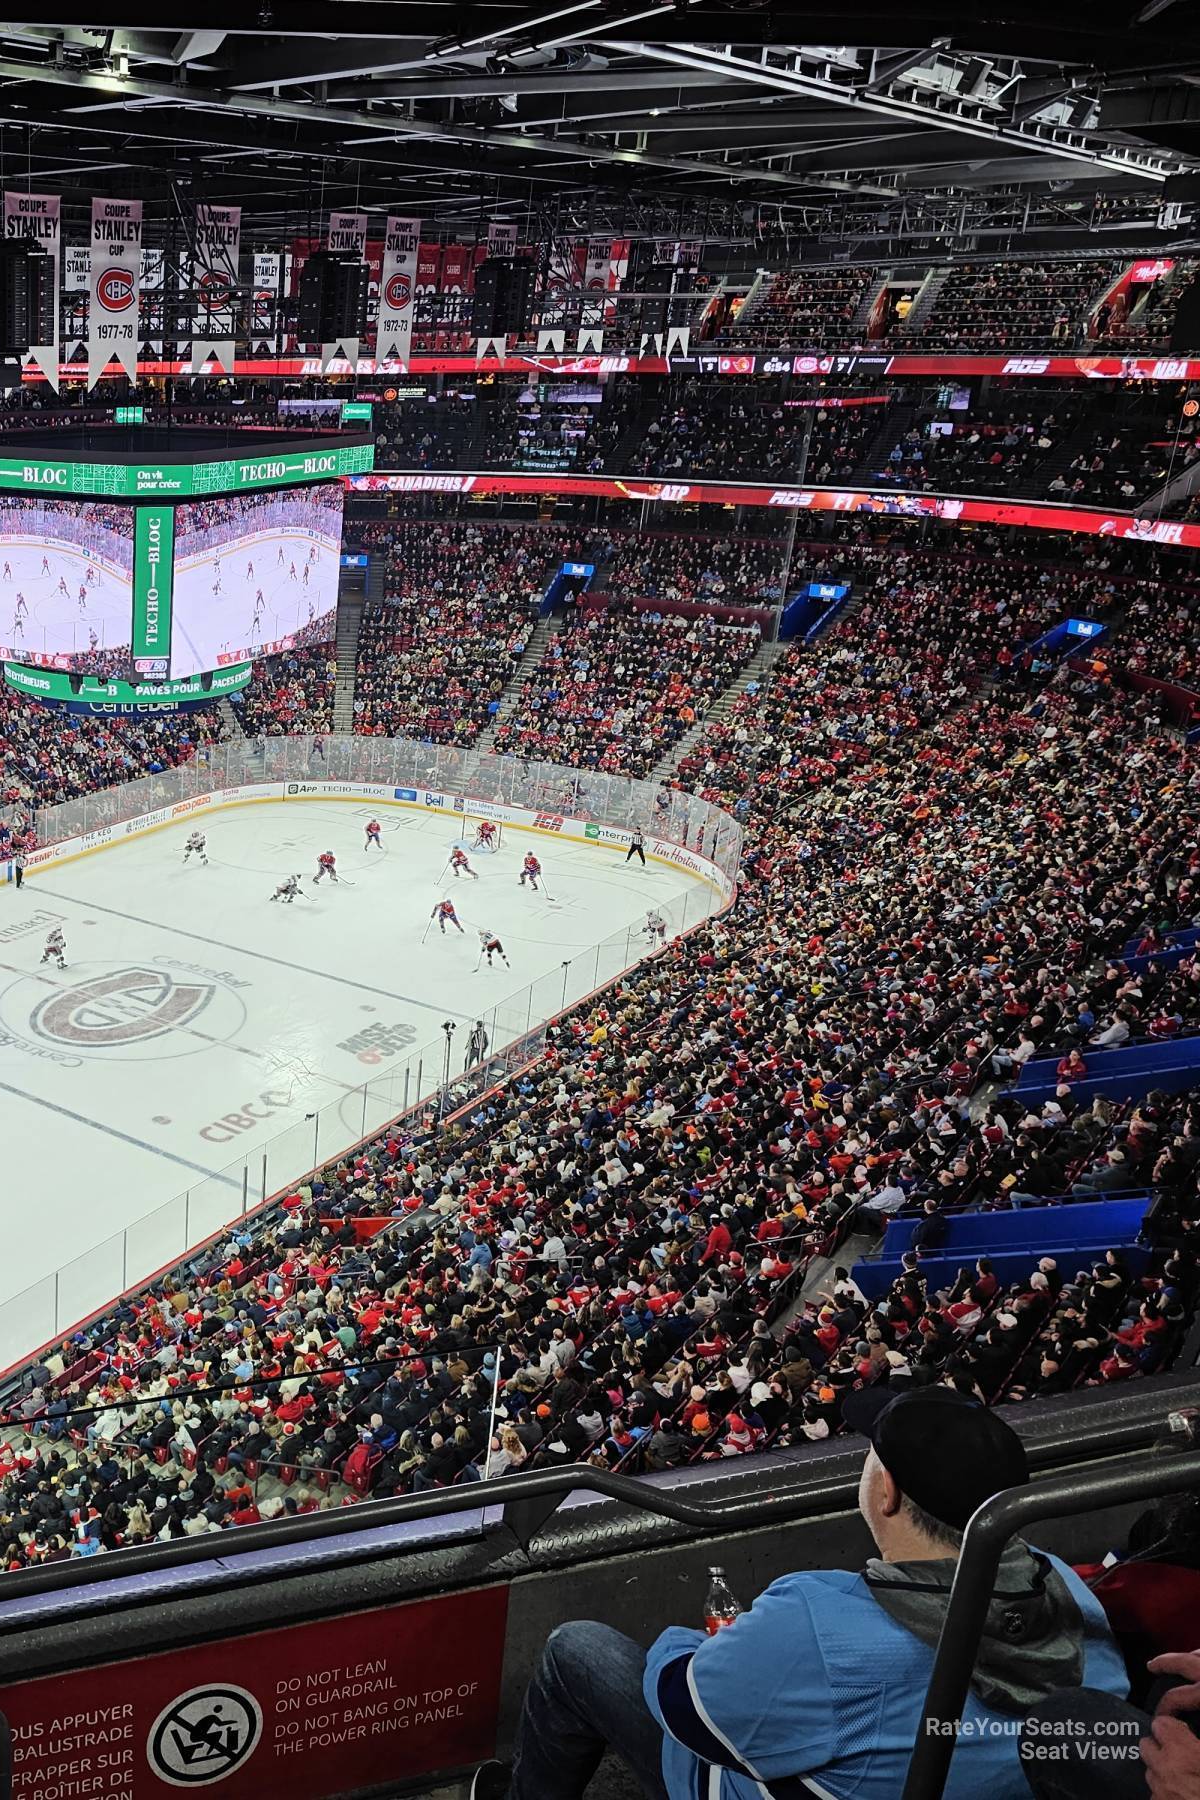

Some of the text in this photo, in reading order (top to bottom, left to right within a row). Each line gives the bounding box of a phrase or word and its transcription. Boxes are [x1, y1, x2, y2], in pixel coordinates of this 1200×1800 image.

[19, 199, 47, 213] COUPE
[105, 204, 130, 217] COUPE
[208, 211, 231, 223] COUPE
[7, 214, 58, 239] STANLEY
[94, 219, 141, 242] STANLEY
[394, 222, 414, 233] COUPE
[197, 224, 239, 246] STANLEY
[330, 231, 365, 250] STANLEY
[386, 233, 419, 252] STANLEY
[74, 250, 90, 259] COUPE
[109, 244, 125, 256] CUP
[396, 254, 407, 264] CUP
[254, 265, 278, 277] STANLEY
[76, 275, 86, 283] CUP
[96, 324, 133, 339] 1977-78
[383, 319, 408, 332] 1972-73
[600, 357, 629, 371] MLB
[721, 360, 730, 370] 0
[763, 361, 790, 372] 6:54
[1152, 362, 1188, 379] NBA
[137, 470, 163, 480] On vit
[137, 479, 182, 490] pour créer
[387, 477, 462, 491] CANADIENS
[660, 485, 690, 499] ATP
[833, 493, 855, 509] F1
[1155, 521, 1185, 542] NFL
[572, 565, 585, 574] Bell
[820, 585, 836, 596] Bell
[1077, 623, 1093, 635] Bell
[172, 682, 200, 695] POUR
[171, 803, 190, 818] pizza
[191, 796, 211, 811] pizza
[425, 793, 444, 807] Bell
[532, 813, 565, 832] IGA
[81, 827, 112, 843] THE KEG
[652, 840, 670, 860] Tim
[670, 848, 703, 873] Hortons
[152, 955, 253, 988] CentreBell
[336, 1022, 394, 1055] MISE
[199, 1102, 276, 1143] CIBC
[276, 1659, 387, 1694] DO NOT LEAN
[275, 1676, 398, 1713] ON GUARDRAIL
[275, 1682, 479, 1738] DO NOT BANG ON TOP OF
[49, 1704, 134, 1734] APPUYER
[274, 1704, 465, 1757] THE POWER RING PANEL
[13, 1724, 134, 1762] BALUSTRADE
[11, 1749, 134, 1788] FRAPPER SUR
[33, 1776, 104, 1800] BOÎTIER
[110, 1769, 134, 1786] DE
